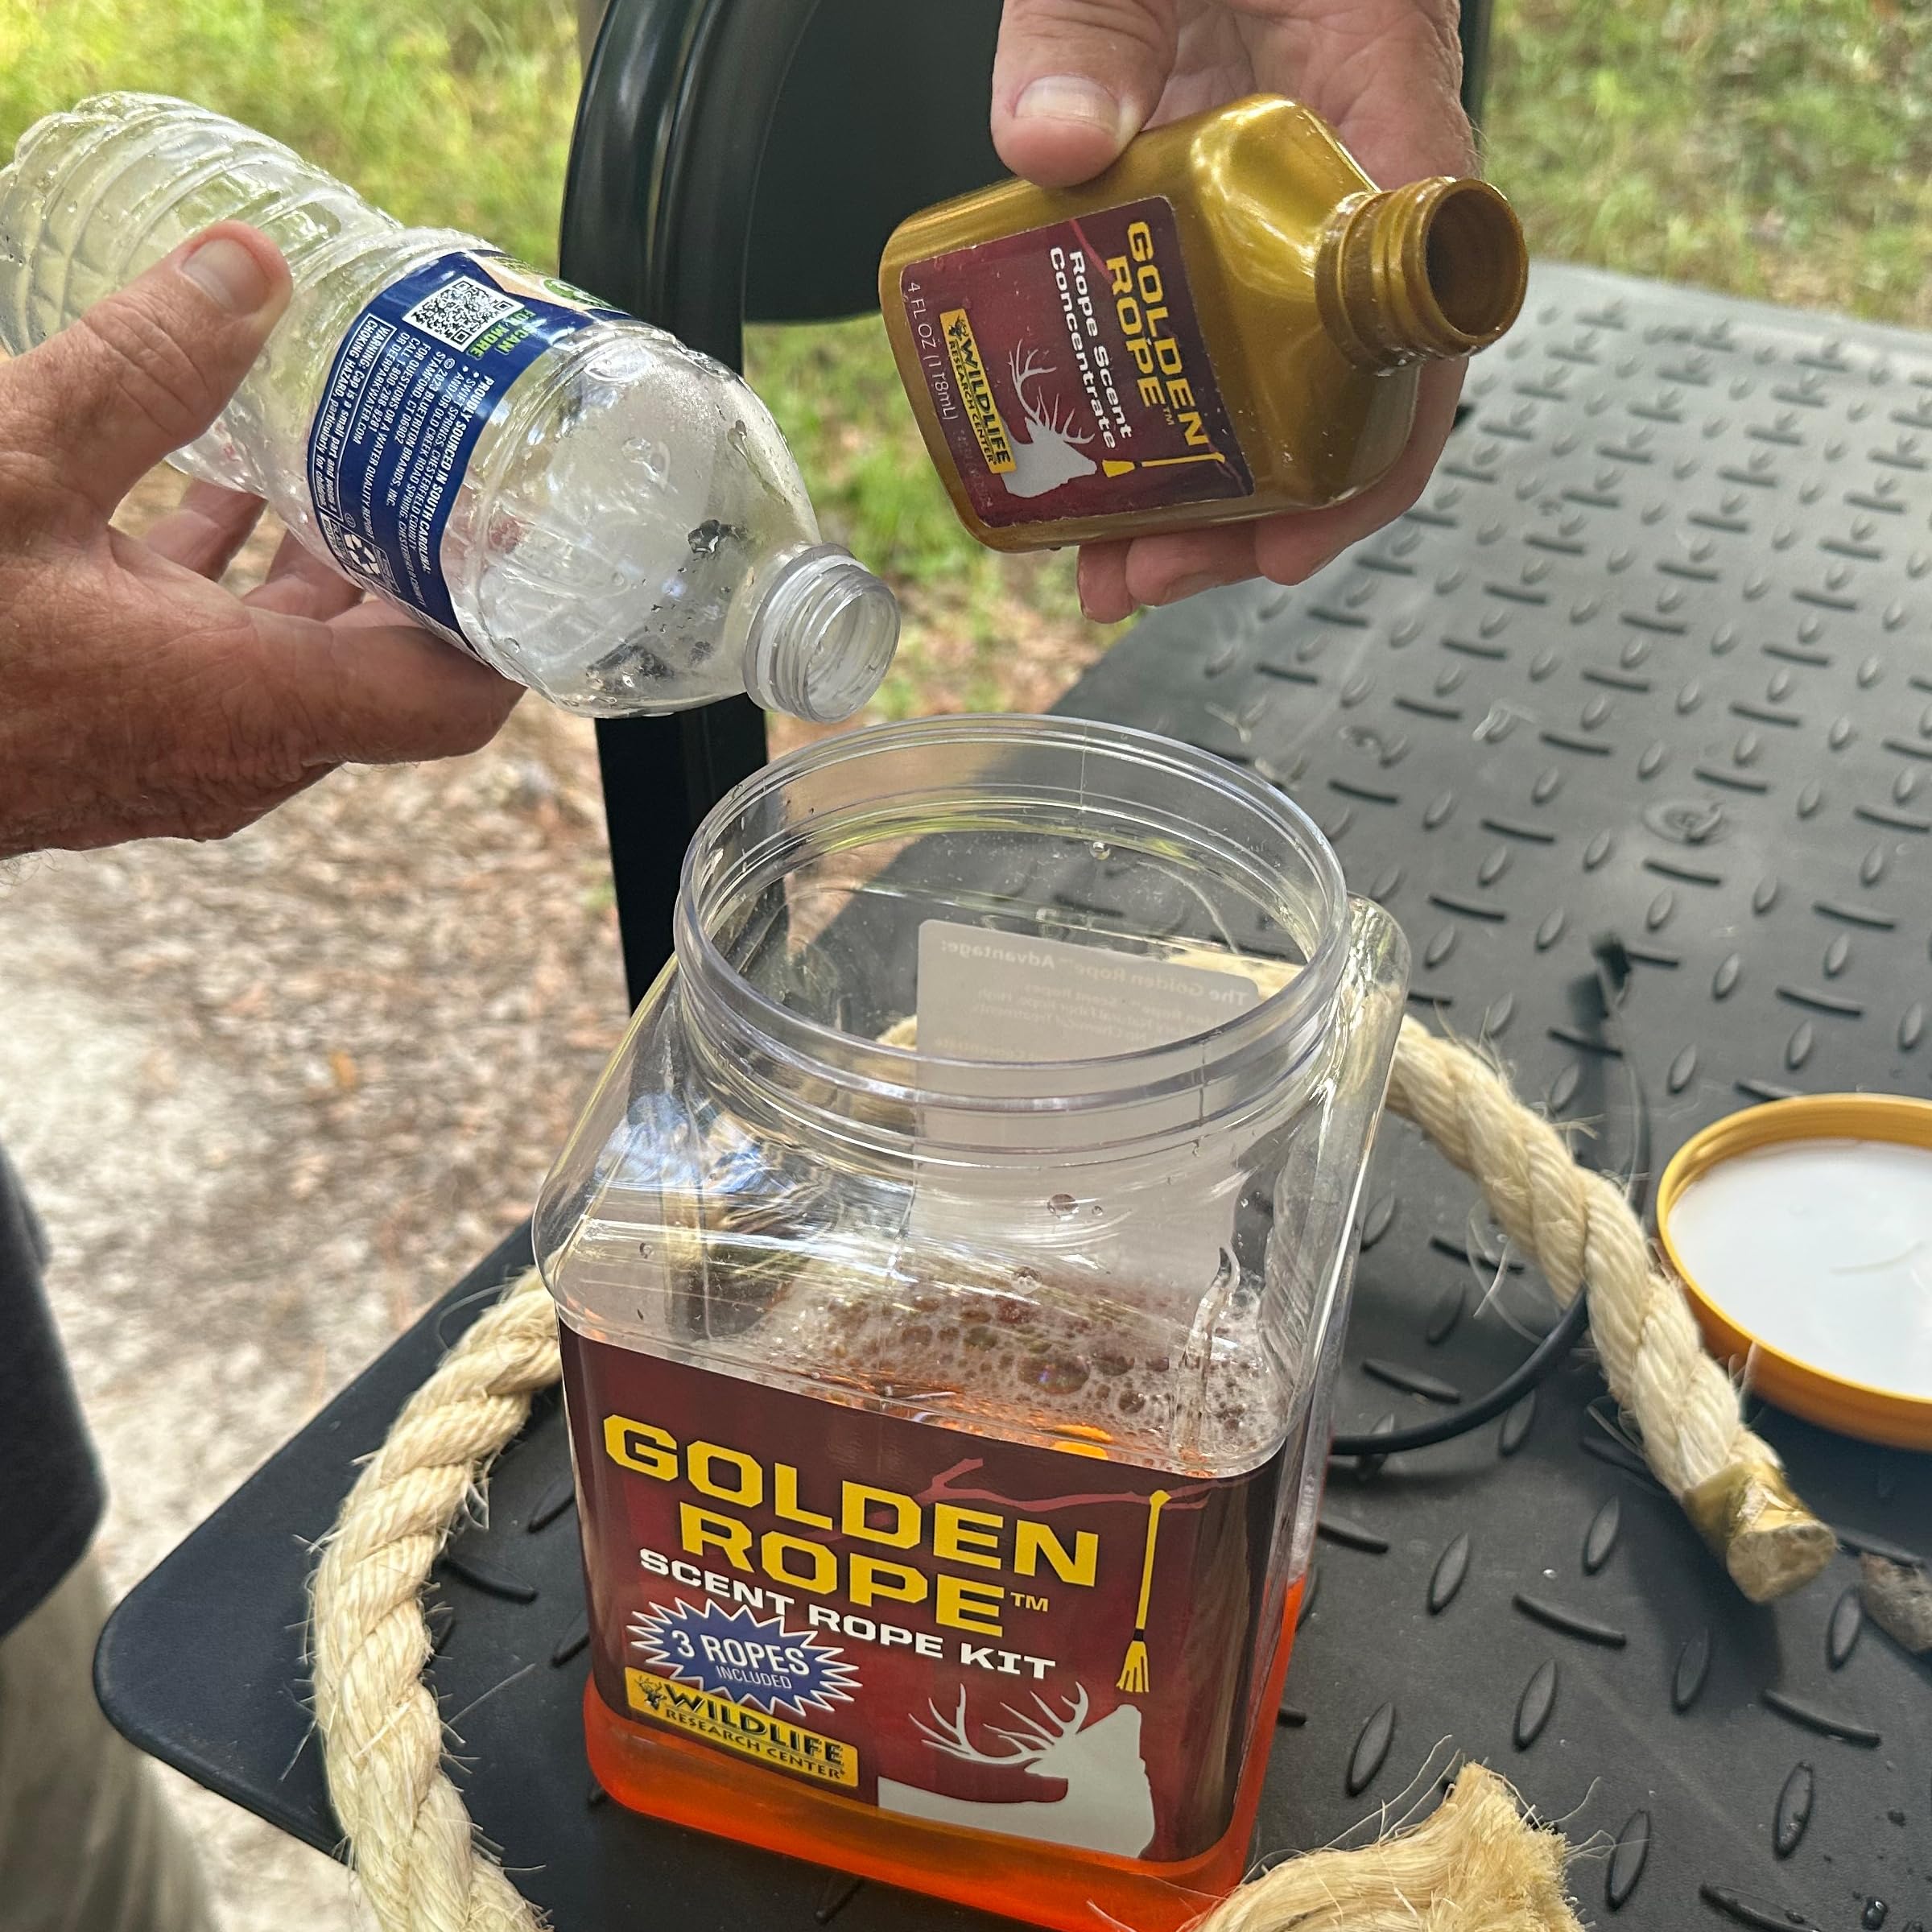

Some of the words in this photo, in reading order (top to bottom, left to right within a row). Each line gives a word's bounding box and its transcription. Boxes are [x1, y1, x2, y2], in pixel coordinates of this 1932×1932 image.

[907, 283, 921, 292] 4
[911, 299, 927, 319] FL
[349, 320, 378, 358] CHOKING
[357, 324, 390, 370] WARNING:
[394, 331, 410, 345] OR
[400, 336, 421, 357] CALL
[413, 341, 431, 361] FOR
[469, 324, 510, 357] MORE
[497, 324, 534, 353] SCAN
[918, 324, 936, 349] OZ
[1050, 246, 1116, 449] Concentrate
[1069, 250, 1098, 337] Rope
[1093, 345, 1132, 439] Scent
[1127, 221, 1210, 447] GOLDEN
[331, 357, 356, 398] HAZARD,
[349, 369, 365, 389] Cap
[387, 358, 419, 410] QUESTIONS
[409, 350, 446, 399] STAMFORD,
[427, 368, 448, 392] 2023
[436, 371, 464, 409] AND/OR
[948, 340, 975, 409] RESEARCH
[342, 399, 352, 408] a
[345, 390, 357, 400] is
[352, 343, 402, 444] DEERPARKWATER.COM
[367, 358, 407, 432] 1-800-288-8281
[403, 399, 417, 414] CT
[452, 378, 476, 407] SWIFT
[459, 375, 494, 422] PROUDLY
[961, 337, 1011, 464] WILDLIFE
[315, 398, 339, 454] particularly
[333, 408, 349, 438] small
[379, 422, 390, 431] A
[382, 408, 395, 424] OR
[393, 412, 412, 444] 06902
[404, 390, 435, 448] BLUETRITON
[429, 407, 444, 427] OLD
[328, 435, 341, 459] part
[368, 431, 388, 466] WATER
[419, 427, 436, 457] CREEK
[440, 420, 467, 470] SOURCED
[315, 453, 325, 470] for
[325, 457, 336, 479] and
[389, 446, 413, 487] BRANDS,
[408, 456, 427, 485] ROAD
[435, 470, 448, 484] IN
[324, 478, 335, 506] poses
[360, 464, 376, 508] QUALITY
[385, 487, 398, 508] INC.
[410, 448, 441, 514] CHESTERFIELD
[421, 483, 442, 521] SOUTH
[361, 505, 374, 540] REPORT
[407, 513, 419, 552] COUNTY
[604, 1414, 1098, 1587] GOLDEN
[640, 1548, 795, 1617] SCENT
[808, 1603, 943, 1659] ROPE
[960, 1642, 1056, 1680] KIT
[671, 1630, 695, 1657] 3
[700, 1634, 811, 1675] ROPES
[716, 1666, 793, 1690] INCLUDED
[663, 1683, 844, 1765] WILDLIFE
[667, 1709, 761, 1752] RESEARCH
